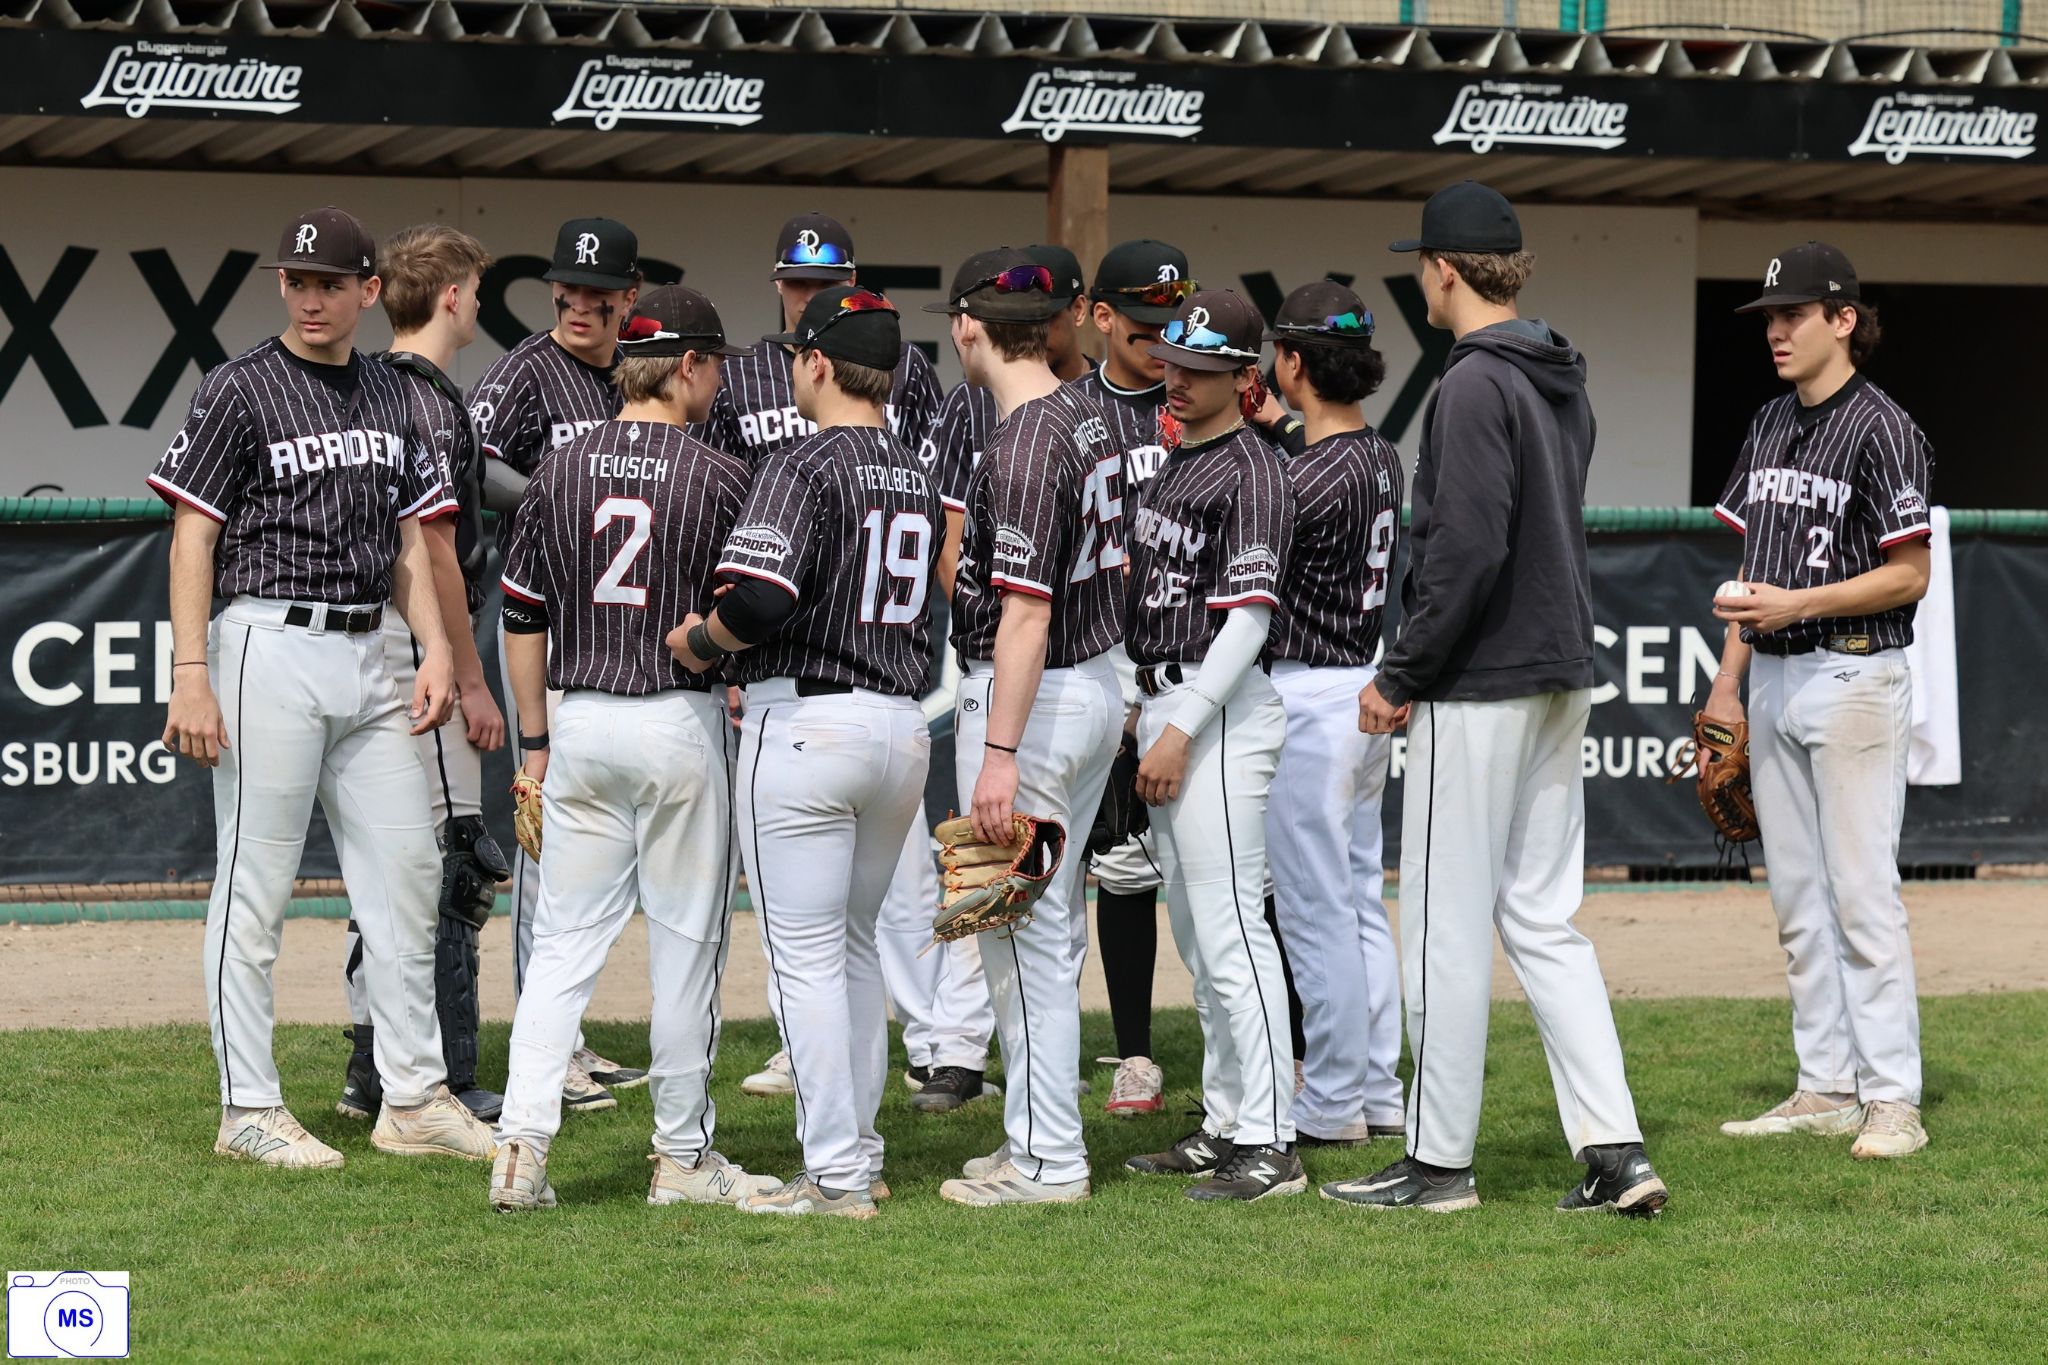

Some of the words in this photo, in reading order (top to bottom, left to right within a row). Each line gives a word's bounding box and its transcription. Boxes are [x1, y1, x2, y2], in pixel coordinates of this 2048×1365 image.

[80, 46, 302, 118] Legionäre
[552, 59, 764, 131] Legionäre
[1001, 71, 1204, 142] Legionäre
[1432, 84, 1628, 154] Legionäre
[1848, 95, 2038, 165] Legionäre
[293, 223, 318, 254] R
[574, 232, 600, 266] R
[1764, 257, 1782, 288] R
[588, 454, 669, 482] TEUSCH
[856, 465, 930, 498] FIERLBECK
[592, 497, 653, 606] 2
[728, 535, 787, 556] ACADEMY
[861, 509, 932, 624] 19
[1, 740, 176, 786] SBURG
